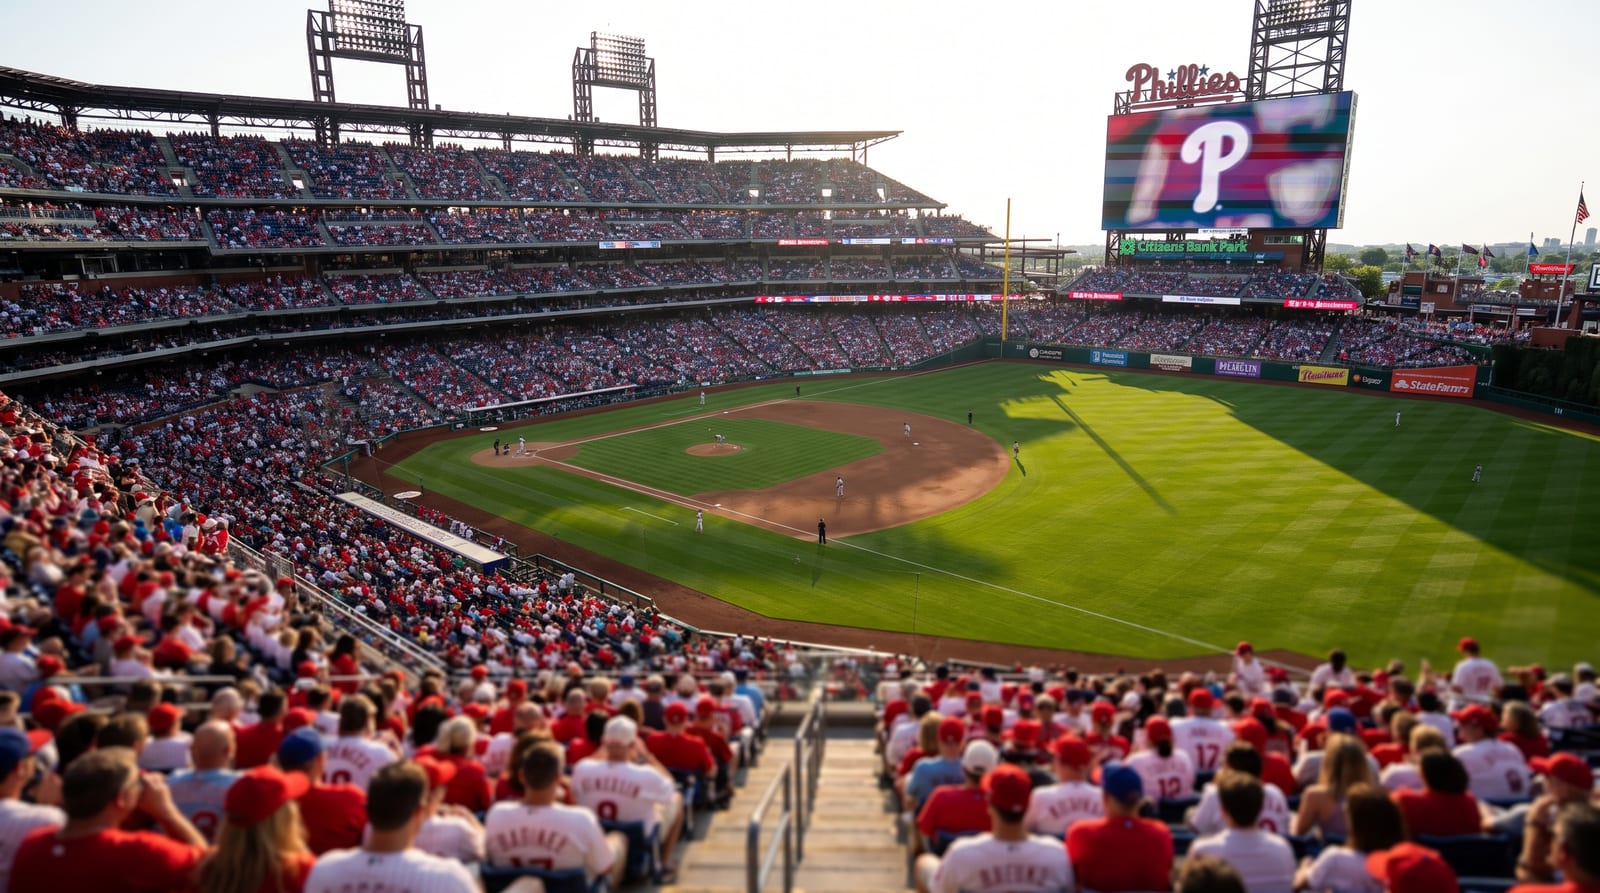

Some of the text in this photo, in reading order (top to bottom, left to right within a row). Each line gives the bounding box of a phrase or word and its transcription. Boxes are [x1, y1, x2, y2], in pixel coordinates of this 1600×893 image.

[1125, 63, 1241, 102] Phillies
[1180, 120, 1250, 213] P
[1186, 240, 1218, 252] Bank
[1219, 239, 1248, 252] Park
[1195, 743, 1220, 771] 17
